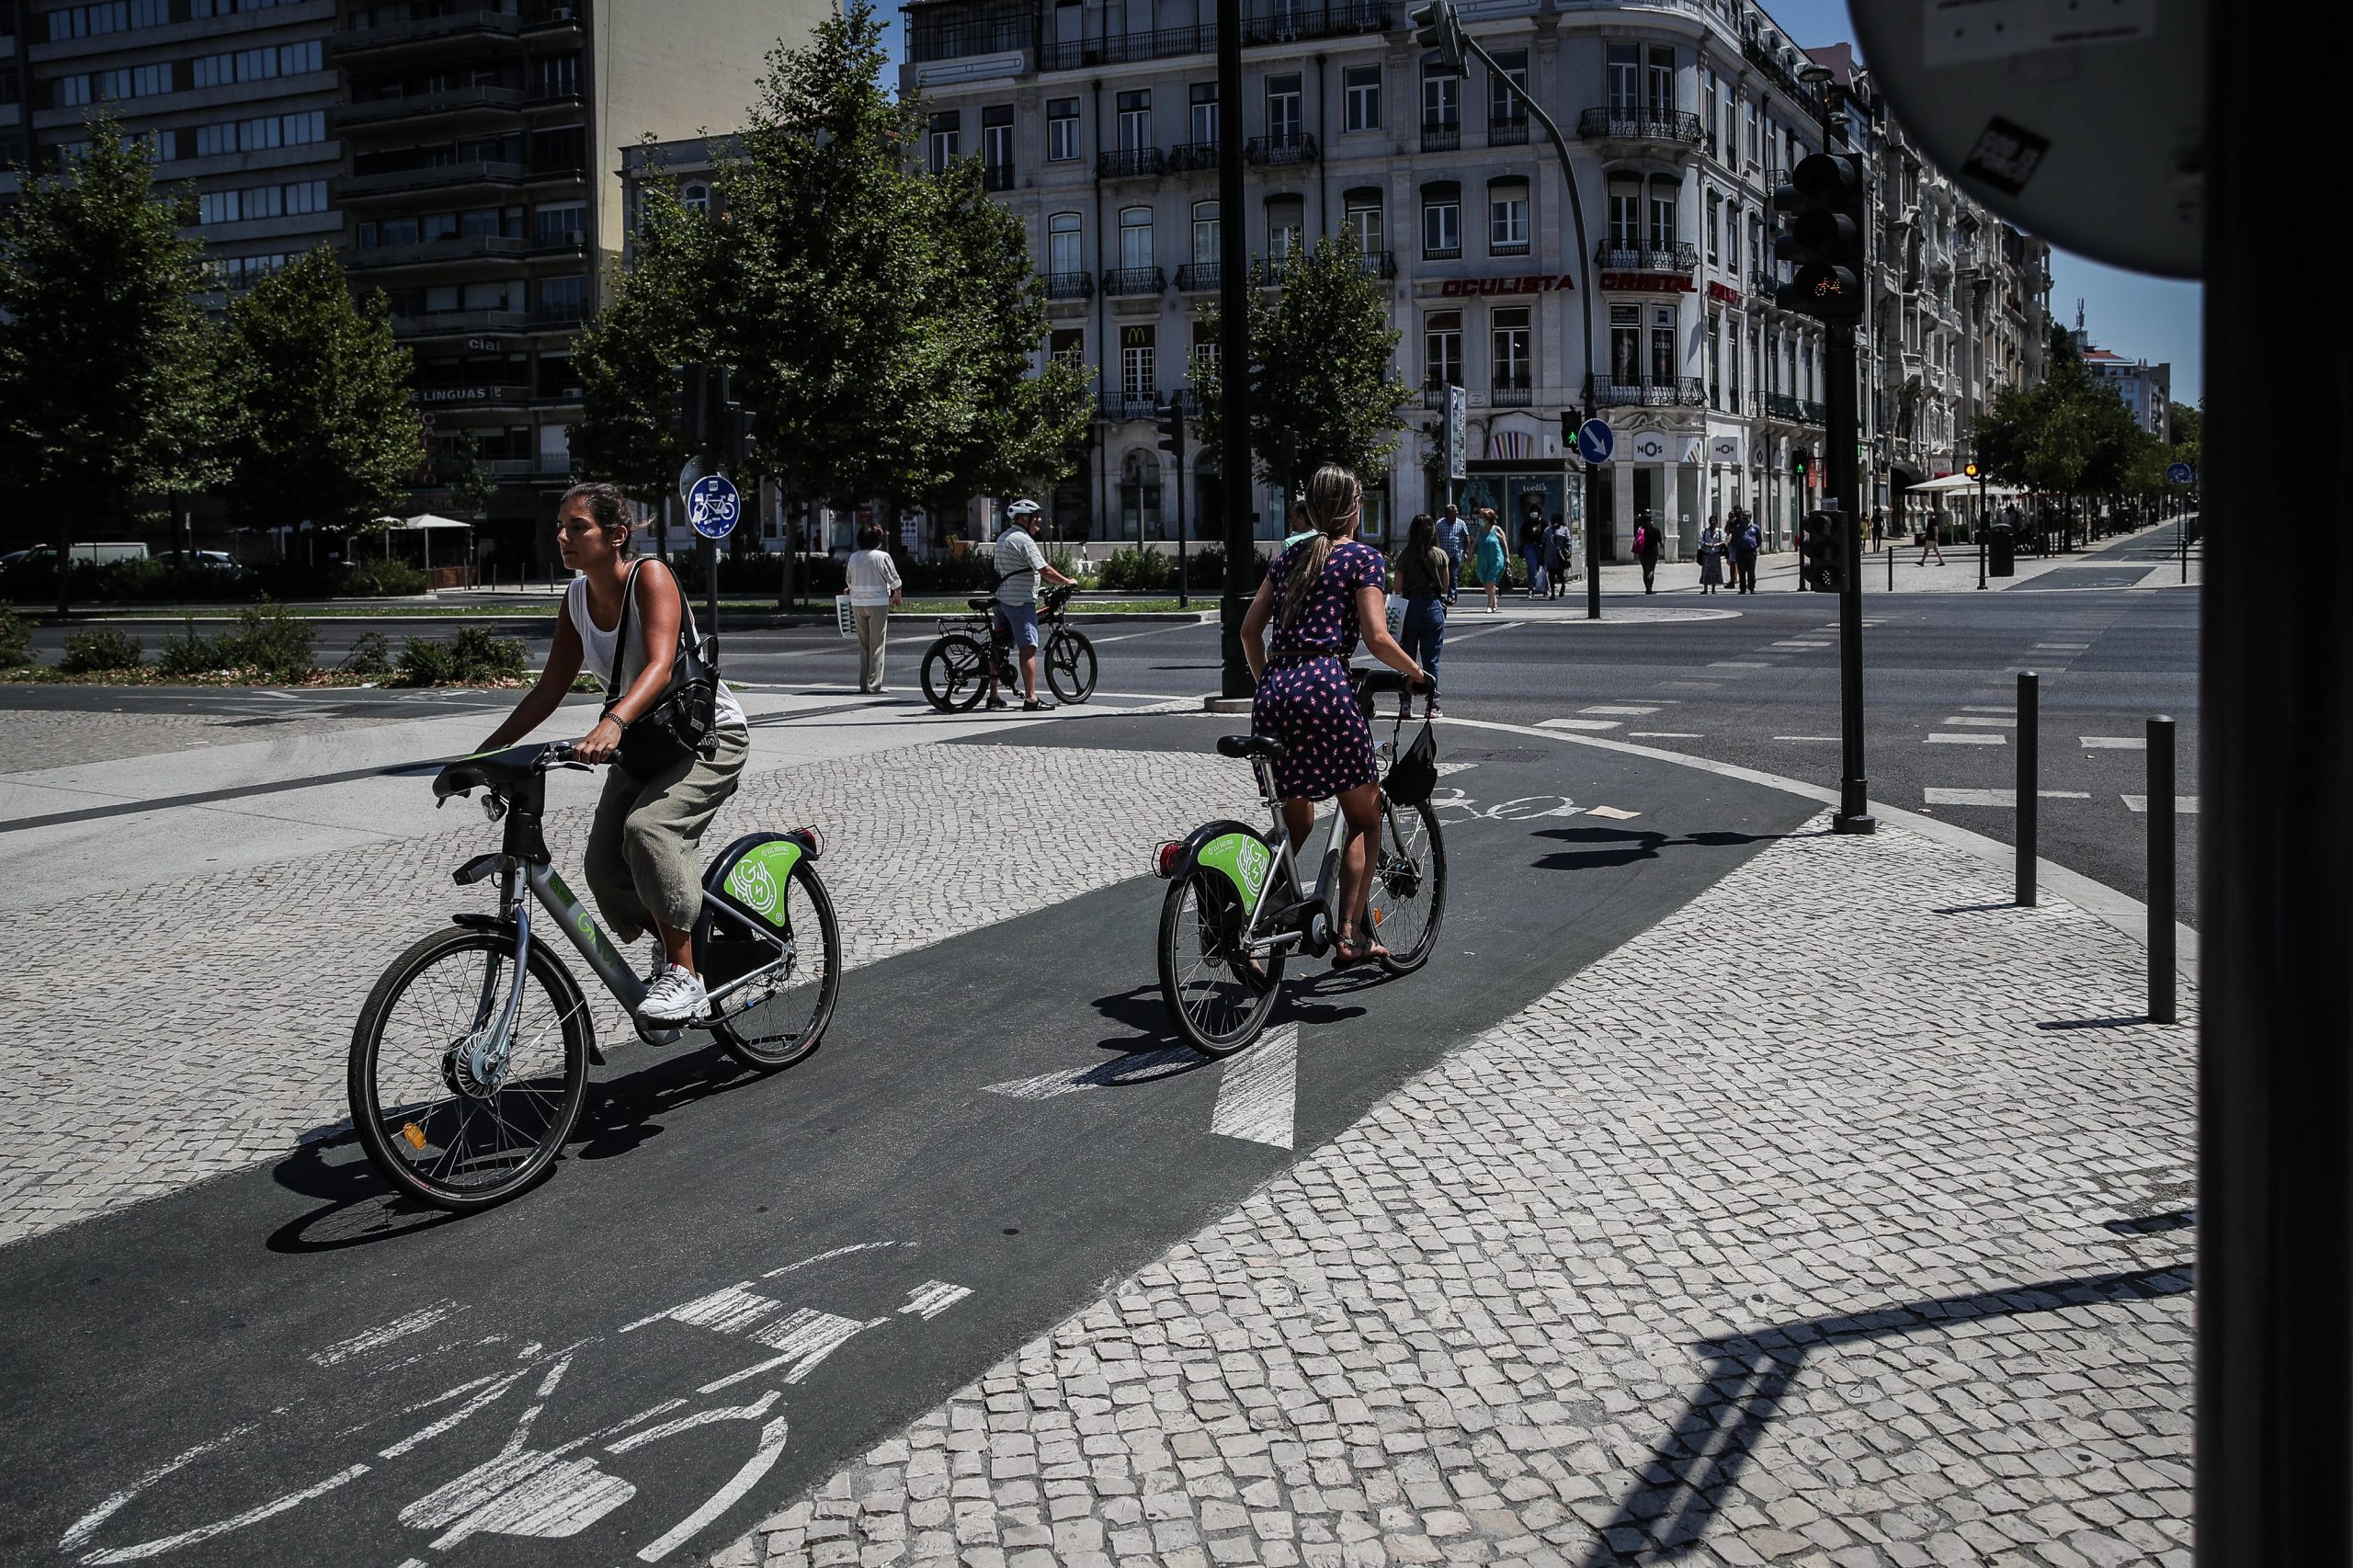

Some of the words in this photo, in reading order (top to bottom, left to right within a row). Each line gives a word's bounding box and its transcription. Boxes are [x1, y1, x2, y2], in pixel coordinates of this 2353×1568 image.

[1442, 275, 1574, 295] OCULISTA
[424, 388, 486, 402] LINGUAS
[1637, 441, 1663, 458] NOS
[1715, 444, 1734, 454] NOS
